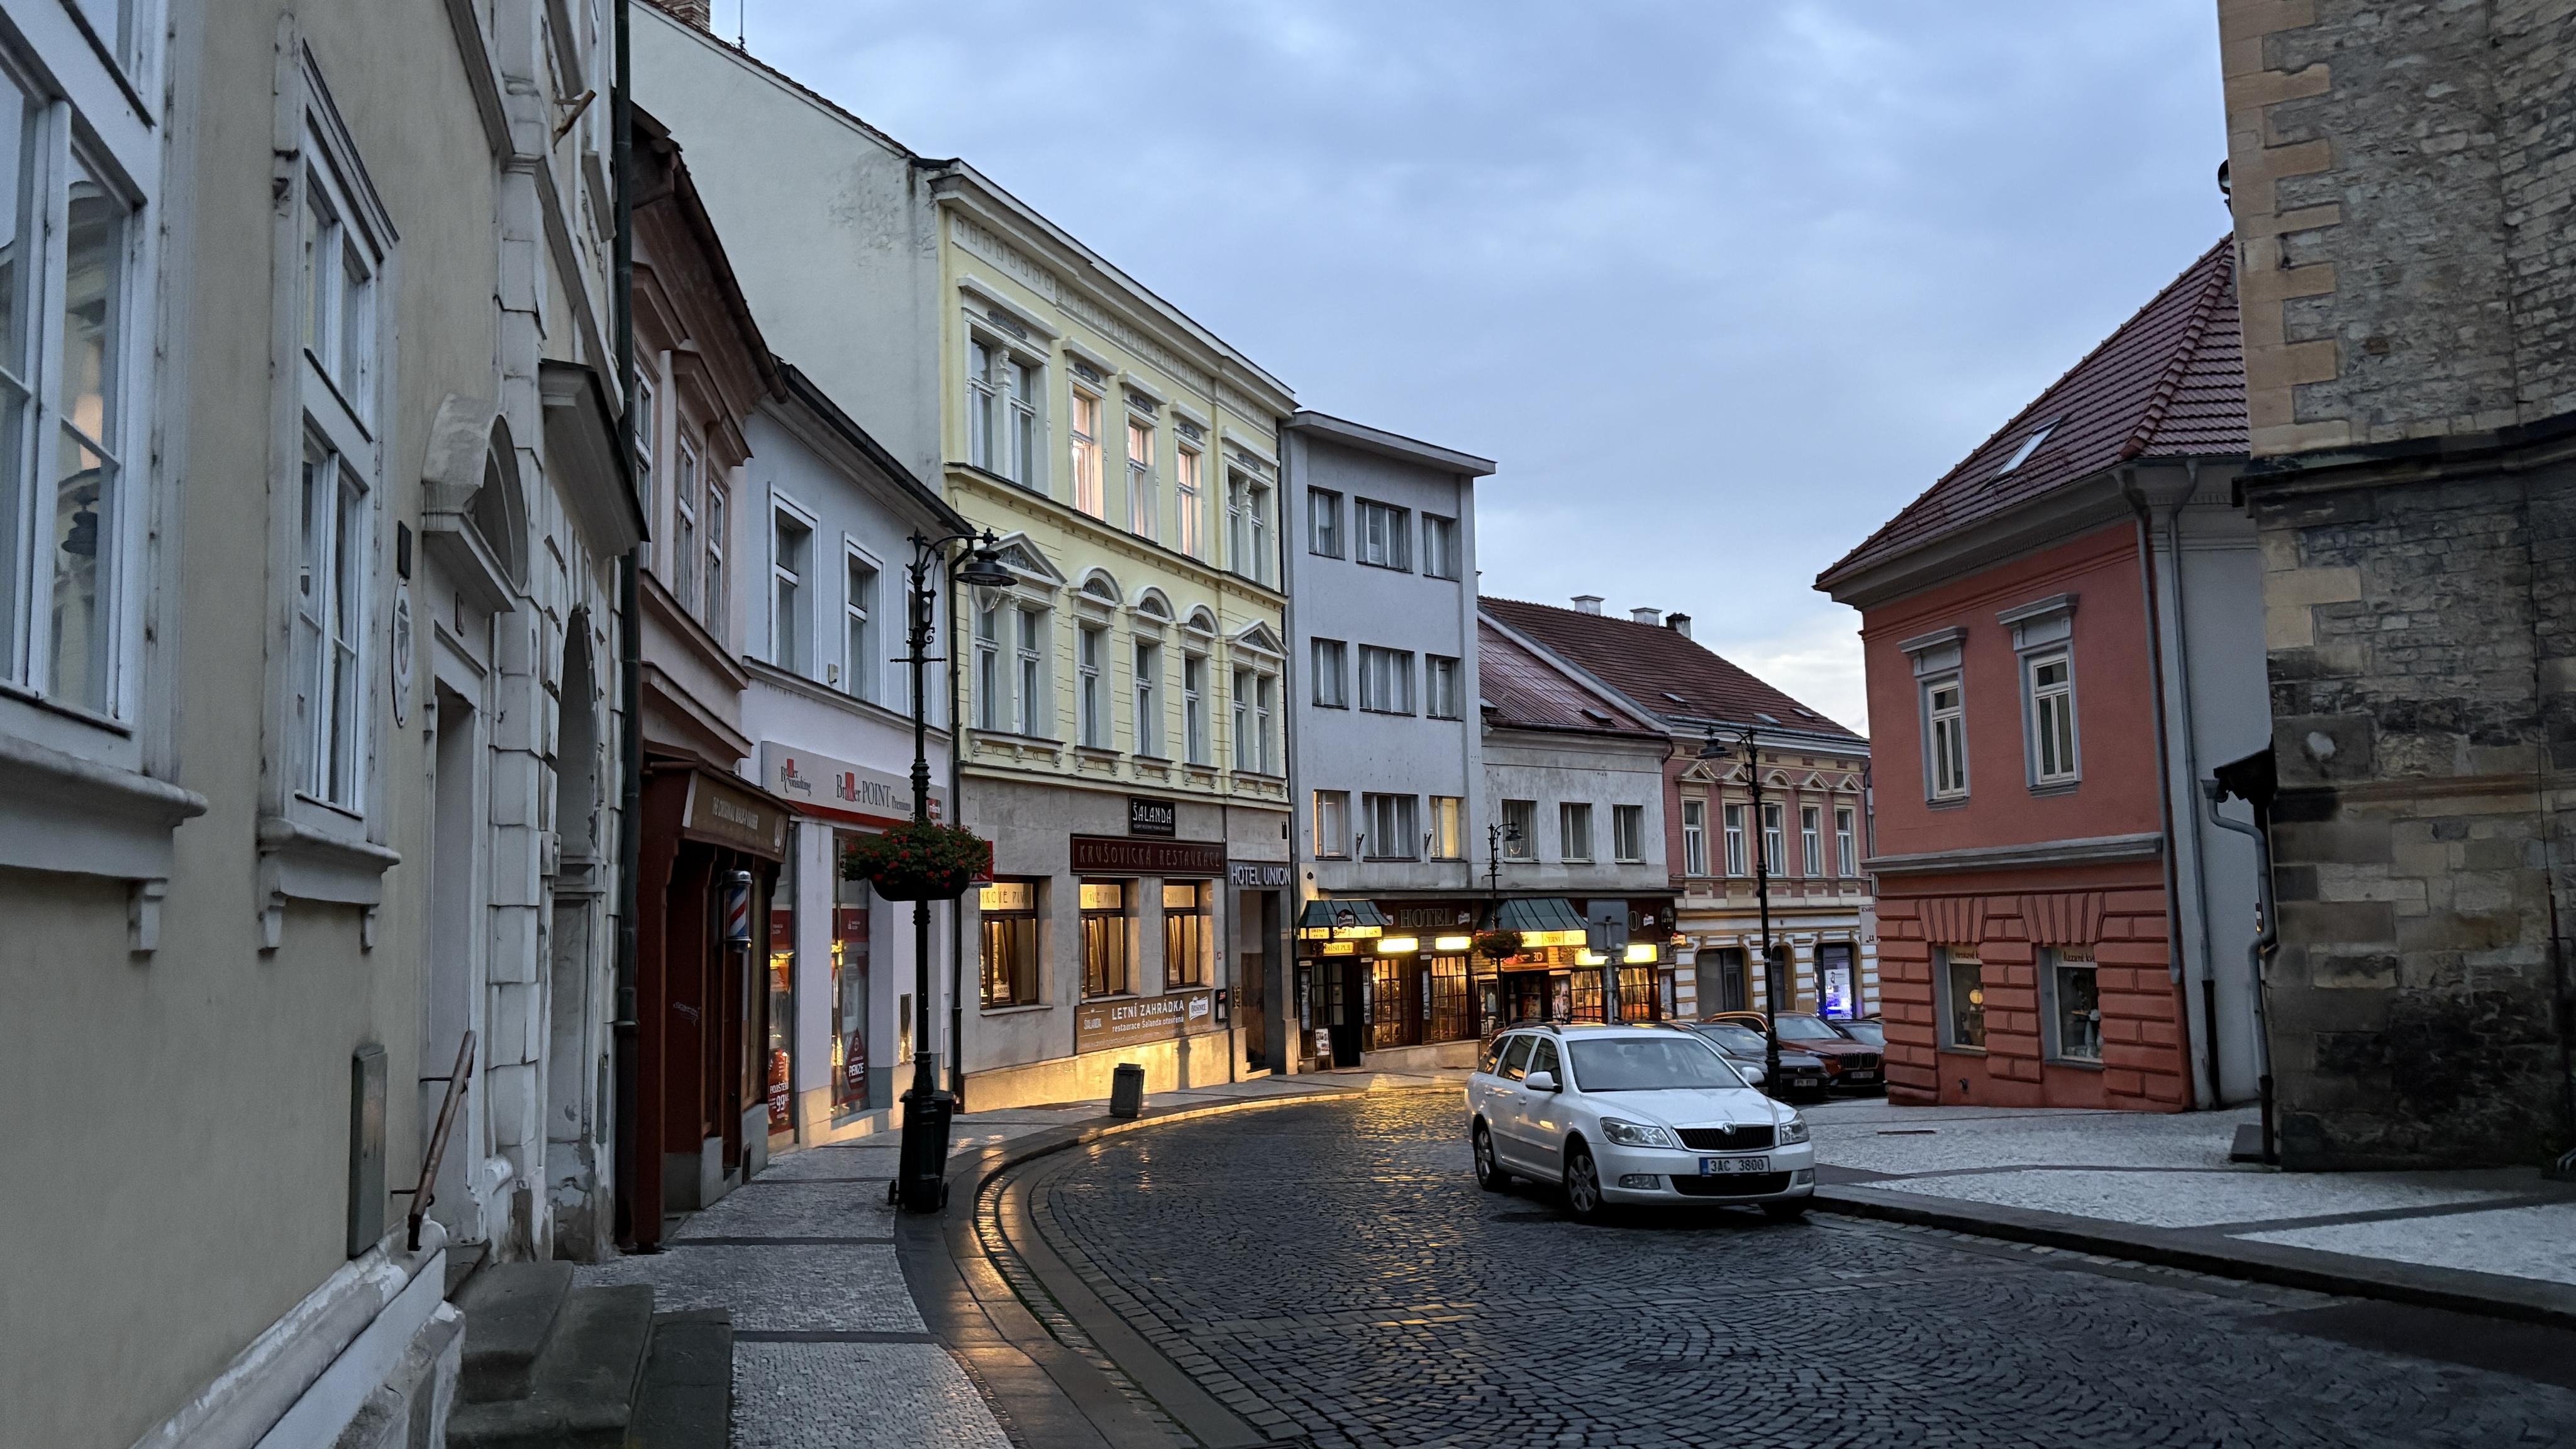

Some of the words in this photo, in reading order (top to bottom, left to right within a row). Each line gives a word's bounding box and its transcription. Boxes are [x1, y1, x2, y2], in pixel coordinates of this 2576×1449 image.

[862, 780, 891, 808] POINT
[1132, 801, 1172, 824] ŠALANDA
[1079, 843, 1152, 865] KRUŠOVICKÁ
[1159, 849, 1221, 867] RESTAURACE
[1231, 865, 1261, 886] HOTEL
[1263, 866, 1291, 886] UNION
[1399, 908, 1455, 928] HOTEL
[1112, 1003, 1138, 1020] LETNÍ
[1140, 1000, 1185, 1017] ZAHRÁDKA
[1112, 1022, 1140, 1033] restaurace
[1141, 1018, 1162, 1029] Šalanda
[776, 1094, 786, 1112] 99
[1710, 1160, 1731, 1172] 3AC
[1738, 1158, 1764, 1172] 3800
